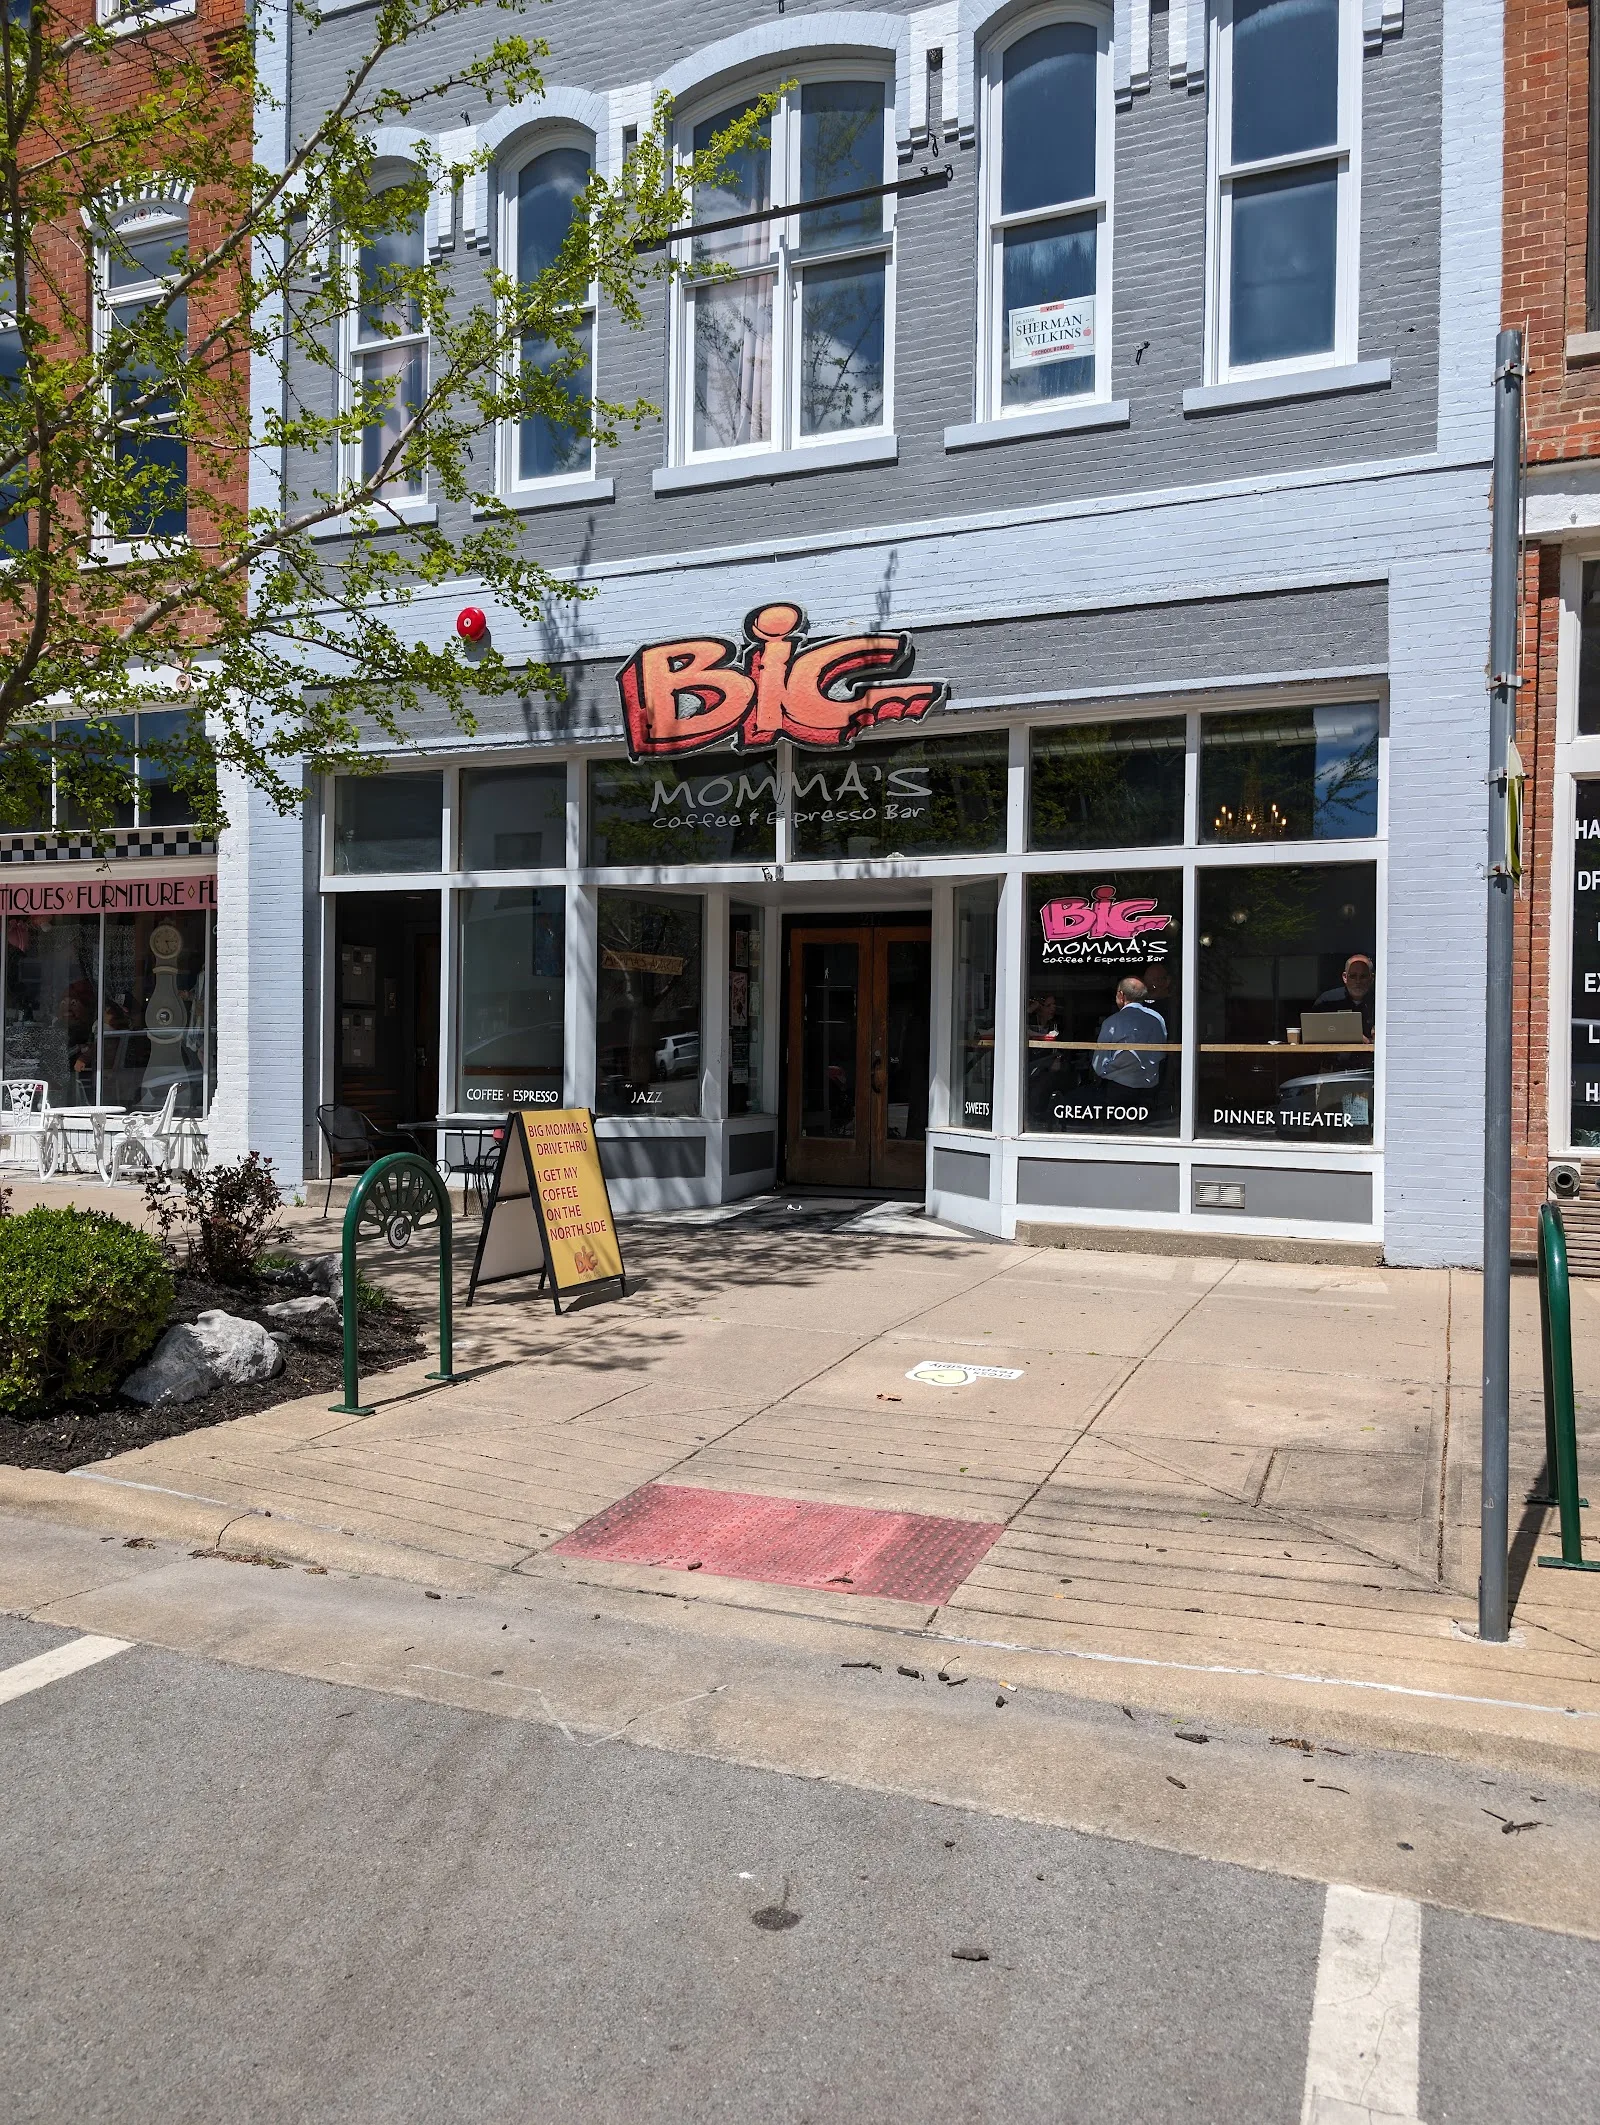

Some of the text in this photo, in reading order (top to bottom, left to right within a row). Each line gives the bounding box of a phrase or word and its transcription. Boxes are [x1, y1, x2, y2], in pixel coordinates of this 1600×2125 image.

[1016, 314, 1083, 337] SHERMAN
[1025, 327, 1082, 347] WILKINS
[650, 762, 933, 813] MOMMA'S
[883, 804, 926, 820] Bar
[76, 881, 185, 909] FURNITURE
[1042, 939, 1168, 956] MOMMA'S
[1094, 956, 1144, 965] Espresso
[1146, 955, 1165, 963] Bar
[466, 1089, 559, 1103] COFFEE ESPRESSO
[631, 1091, 662, 1103] JAZZ
[965, 1101, 990, 1116] SWEETS
[1054, 1105, 1149, 1121] GREAT FOOD
[1213, 1109, 1276, 1125] DINNER
[1280, 1111, 1354, 1128] THEATER
[528, 1125, 544, 1138] BIG
[536, 1140, 588, 1155] DRIVE THRU
[538, 1167, 578, 1182] I GET MY
[542, 1186, 579, 1201] COFFEE
[546, 1205, 582, 1221] ON THE
[549, 1220, 607, 1241] NORTH SIDE
